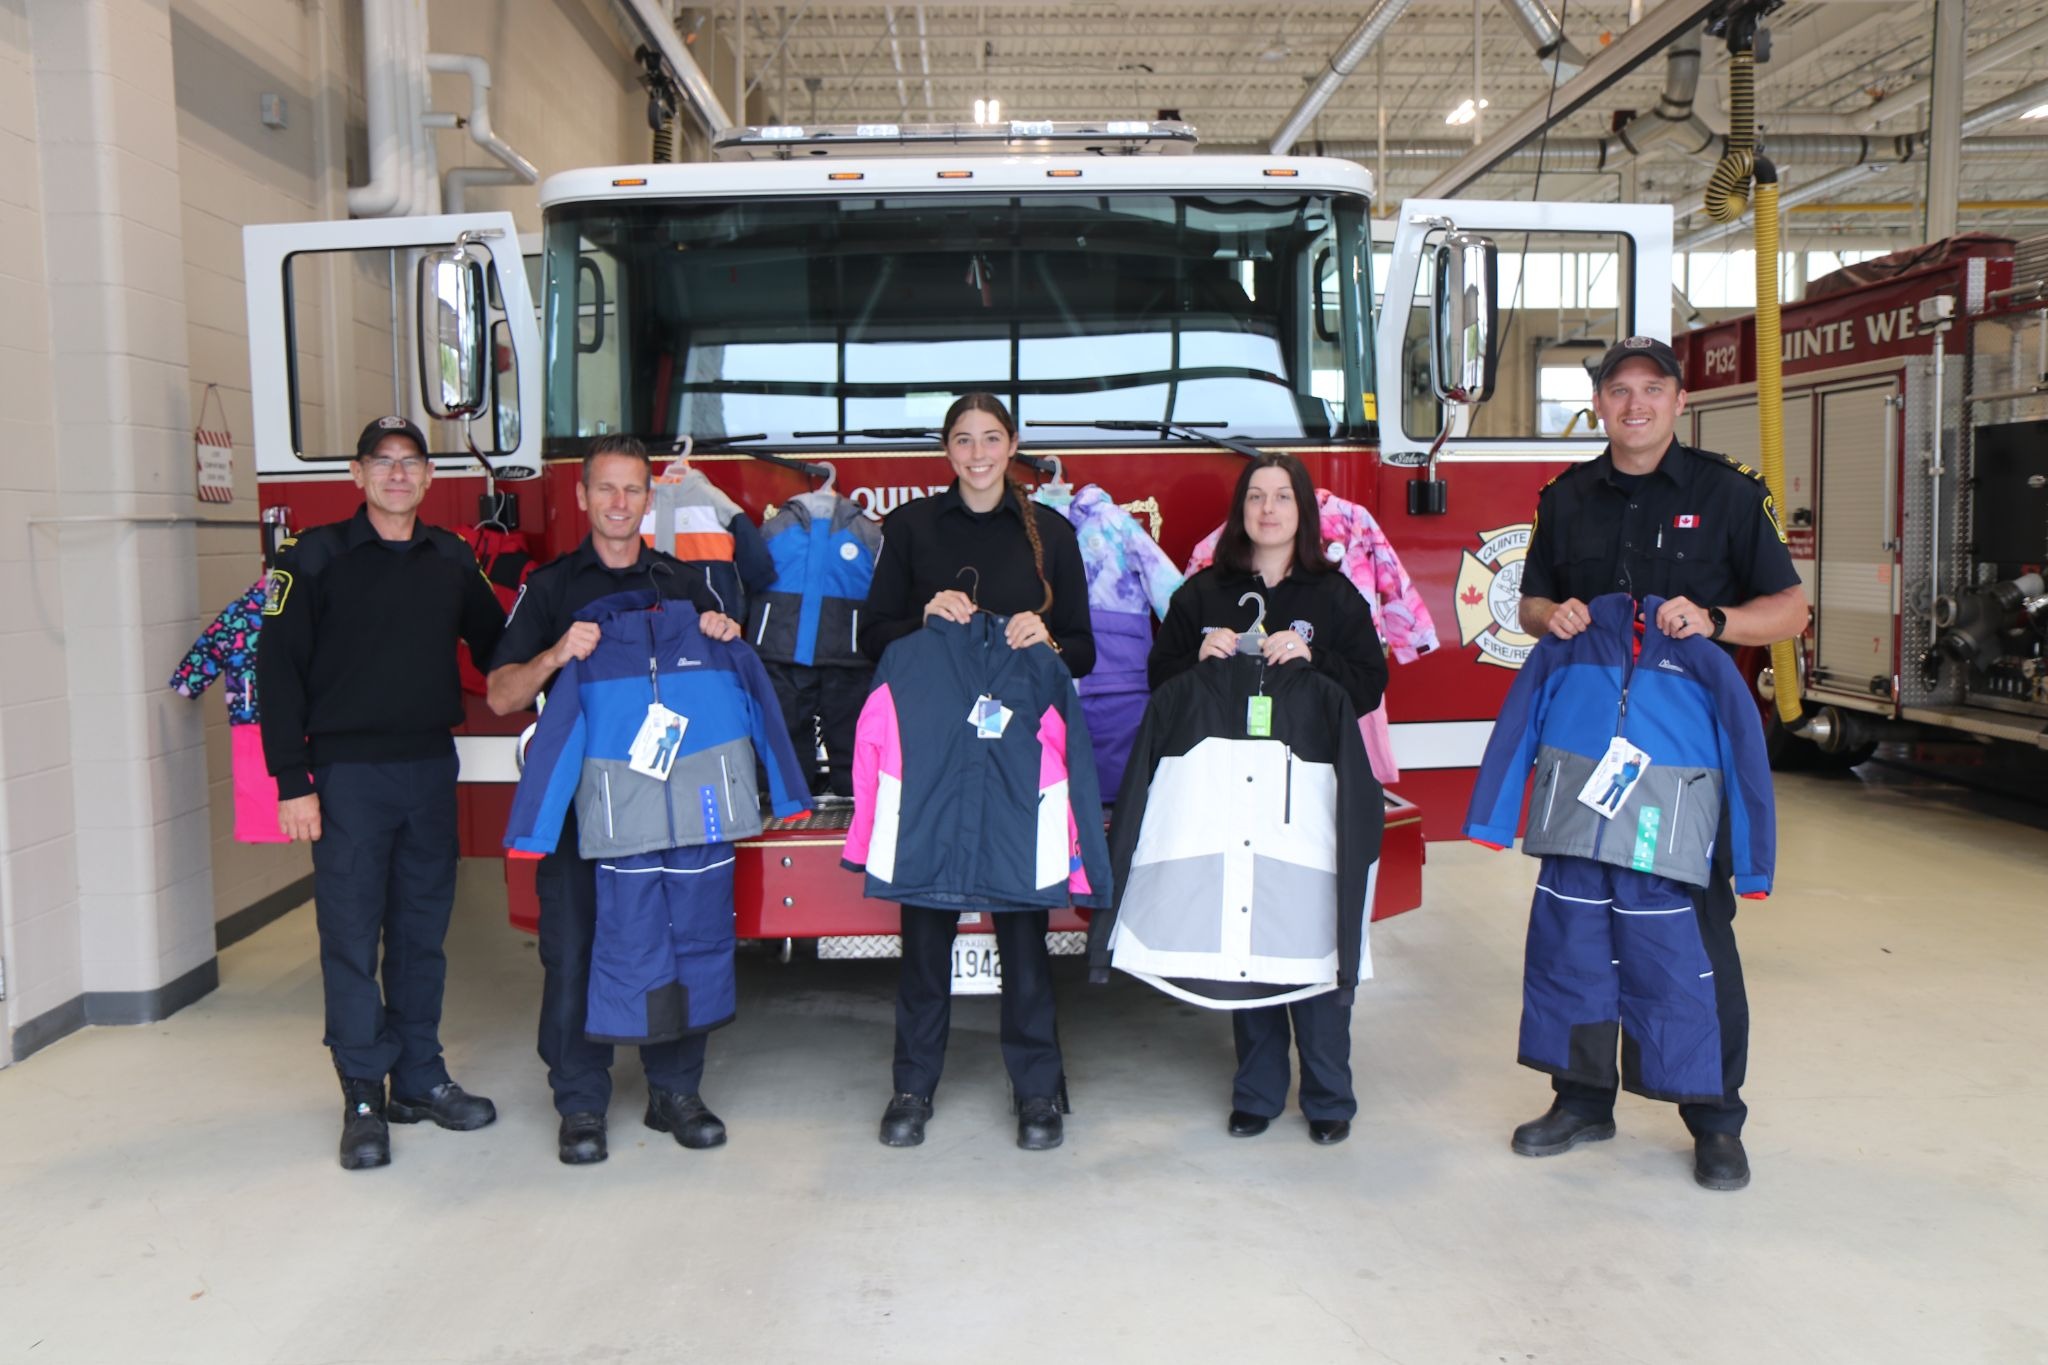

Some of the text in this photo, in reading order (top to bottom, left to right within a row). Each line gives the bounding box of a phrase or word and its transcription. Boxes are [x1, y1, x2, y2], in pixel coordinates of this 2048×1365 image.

[1781, 320, 1855, 361] UINTE
[1705, 345, 1736, 376] P132
[1483, 532, 1527, 560] QUINTE
[1484, 637, 1529, 659] FIRE/RE
